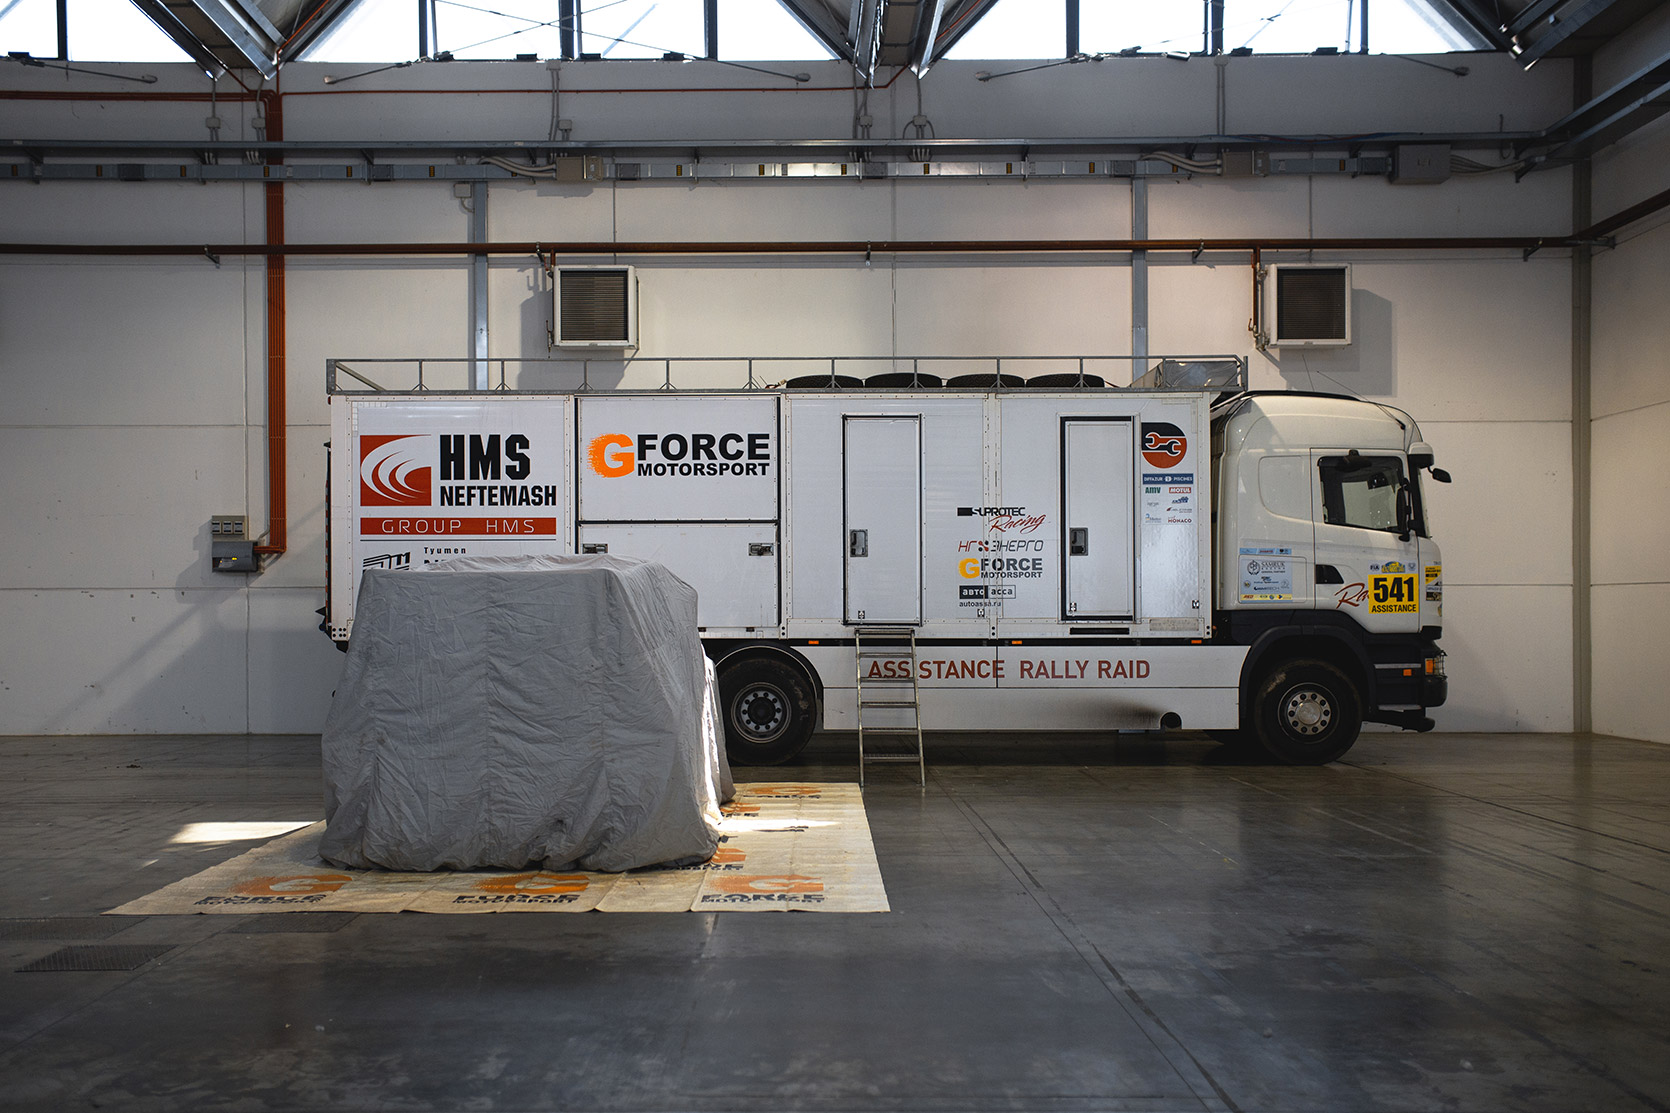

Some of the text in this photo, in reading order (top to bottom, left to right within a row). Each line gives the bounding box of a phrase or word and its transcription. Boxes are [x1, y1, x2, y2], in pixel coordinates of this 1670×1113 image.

[440, 434, 531, 481] HMS
[638, 462, 770, 477] MOTORSPORT
[440, 485, 557, 507] NEFTEMASH
[971, 507, 1026, 516] SUPROTEC
[381, 519, 535, 534] GROUP HMS
[988, 514, 1047, 535] Racing
[423, 546, 467, 555] Tyumen
[980, 571, 1043, 579] MOTORSPORT
[1373, 576, 1415, 603] 541
[1371, 604, 1417, 613] ASSISTANCE
[868, 660, 1150, 679] ASSSTANCE RALLY RAID
